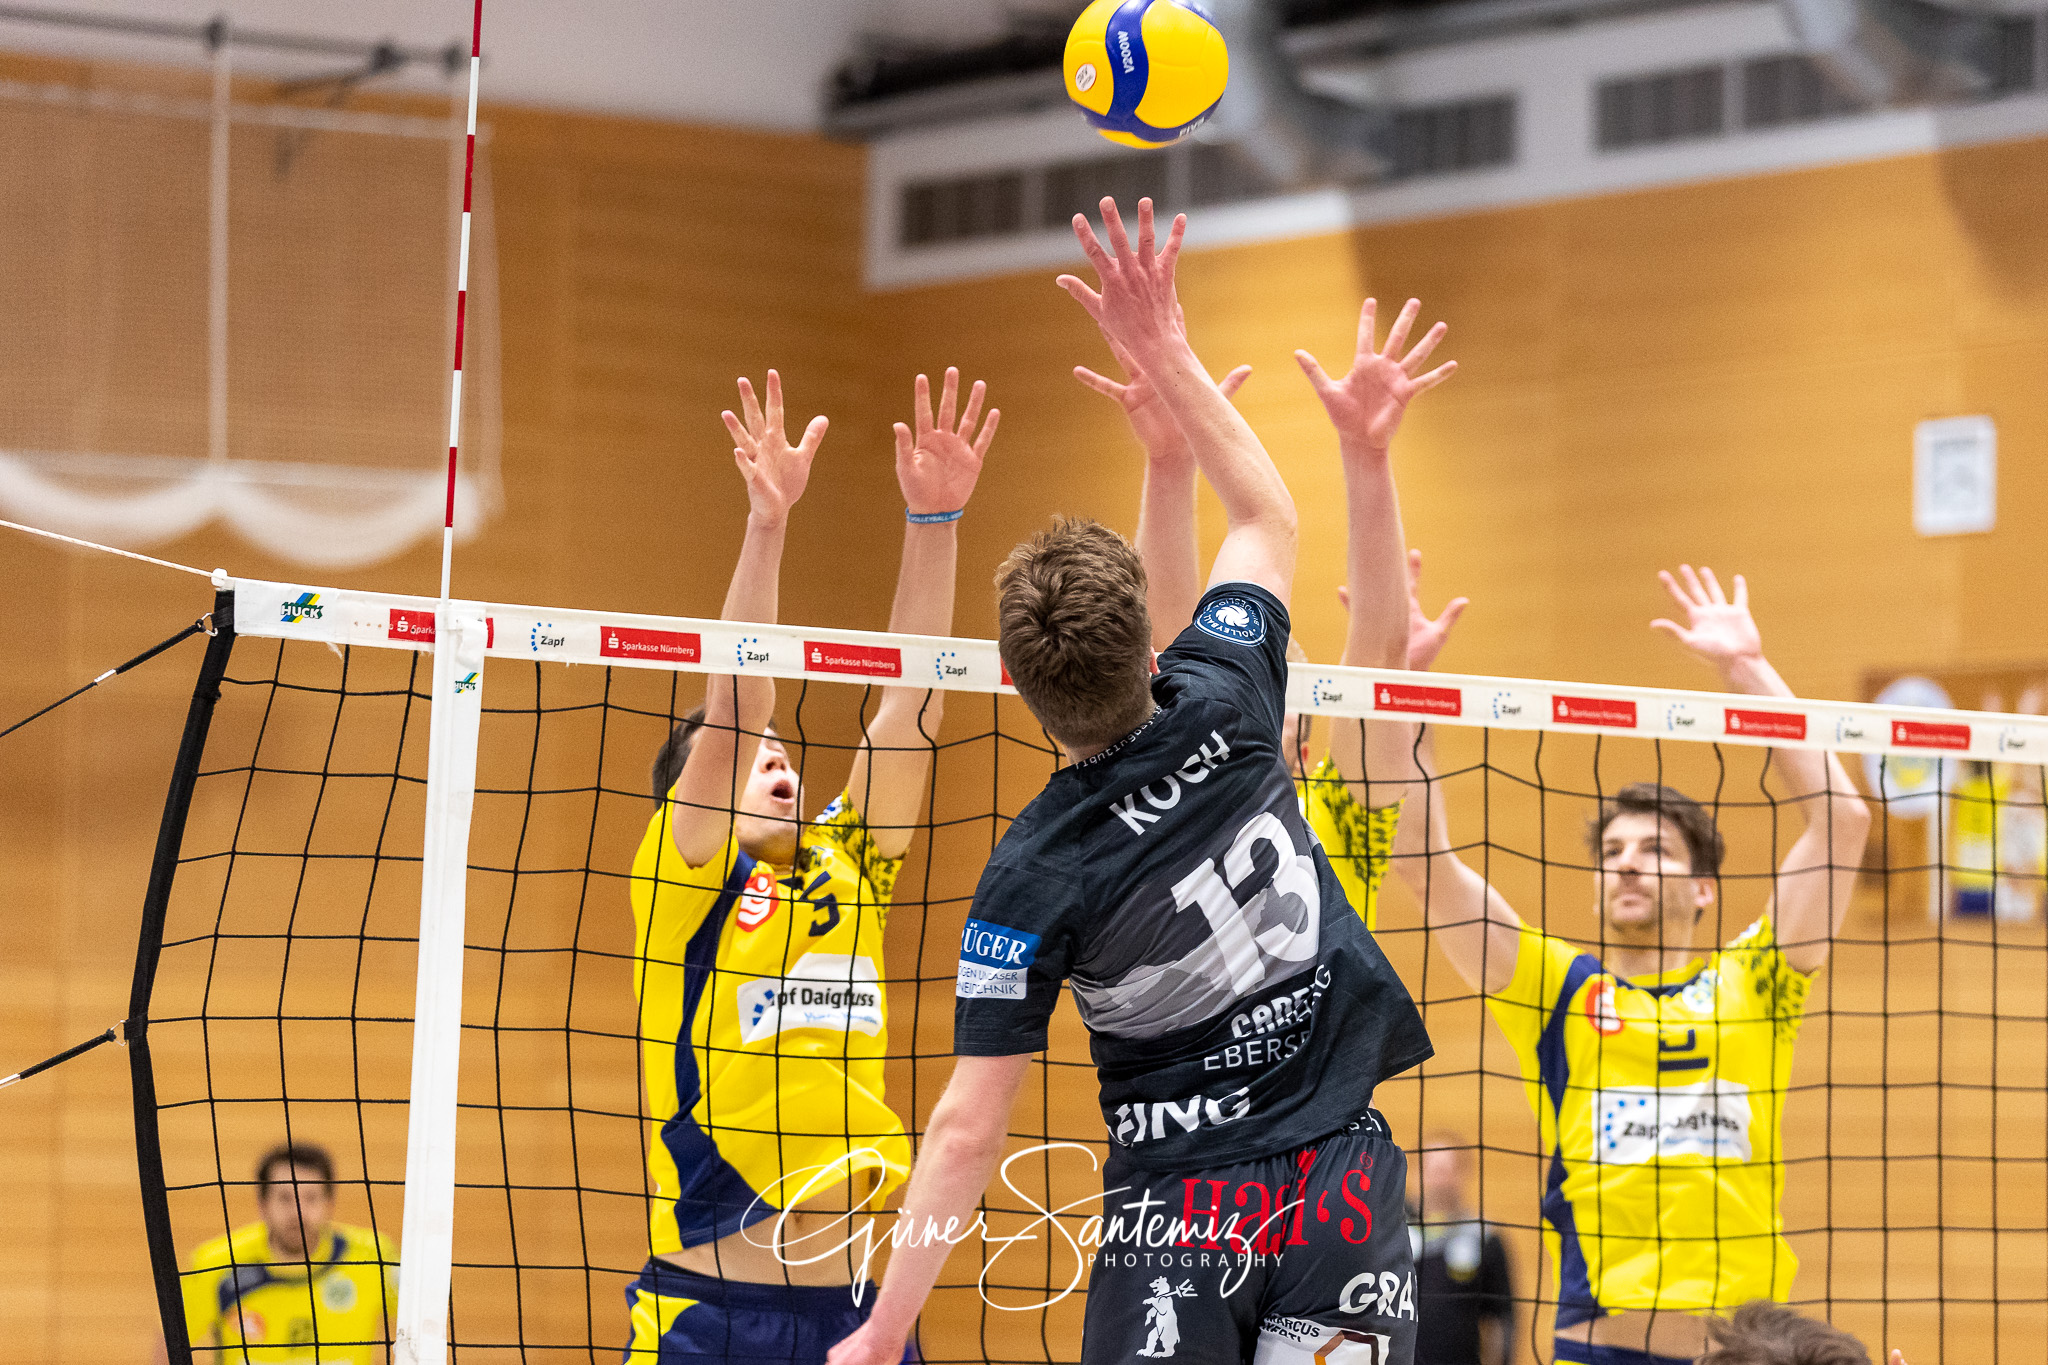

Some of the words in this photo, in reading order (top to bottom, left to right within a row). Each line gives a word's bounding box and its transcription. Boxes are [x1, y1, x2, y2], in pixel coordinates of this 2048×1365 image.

[1117, 30, 1135, 74] V200W
[280, 601, 324, 620] HUCK
[540, 636, 565, 647] Zapf
[621, 640, 659, 653] Sparkasse
[660, 644, 695, 657] Nürnberg
[746, 651, 770, 662] Zapf
[824, 655, 861, 668] Sparkasse
[861, 658, 896, 671] Nürnberg
[945, 665, 967, 676] Zapf
[1321, 691, 1343, 702] Zapf
[1108, 729, 1231, 836] KOCH
[1170, 811, 1321, 997] 13
[961, 922, 1027, 965] ÜGER
[800, 986, 875, 1009] Daigfuss
[1338, 1270, 1418, 1322] GRA
